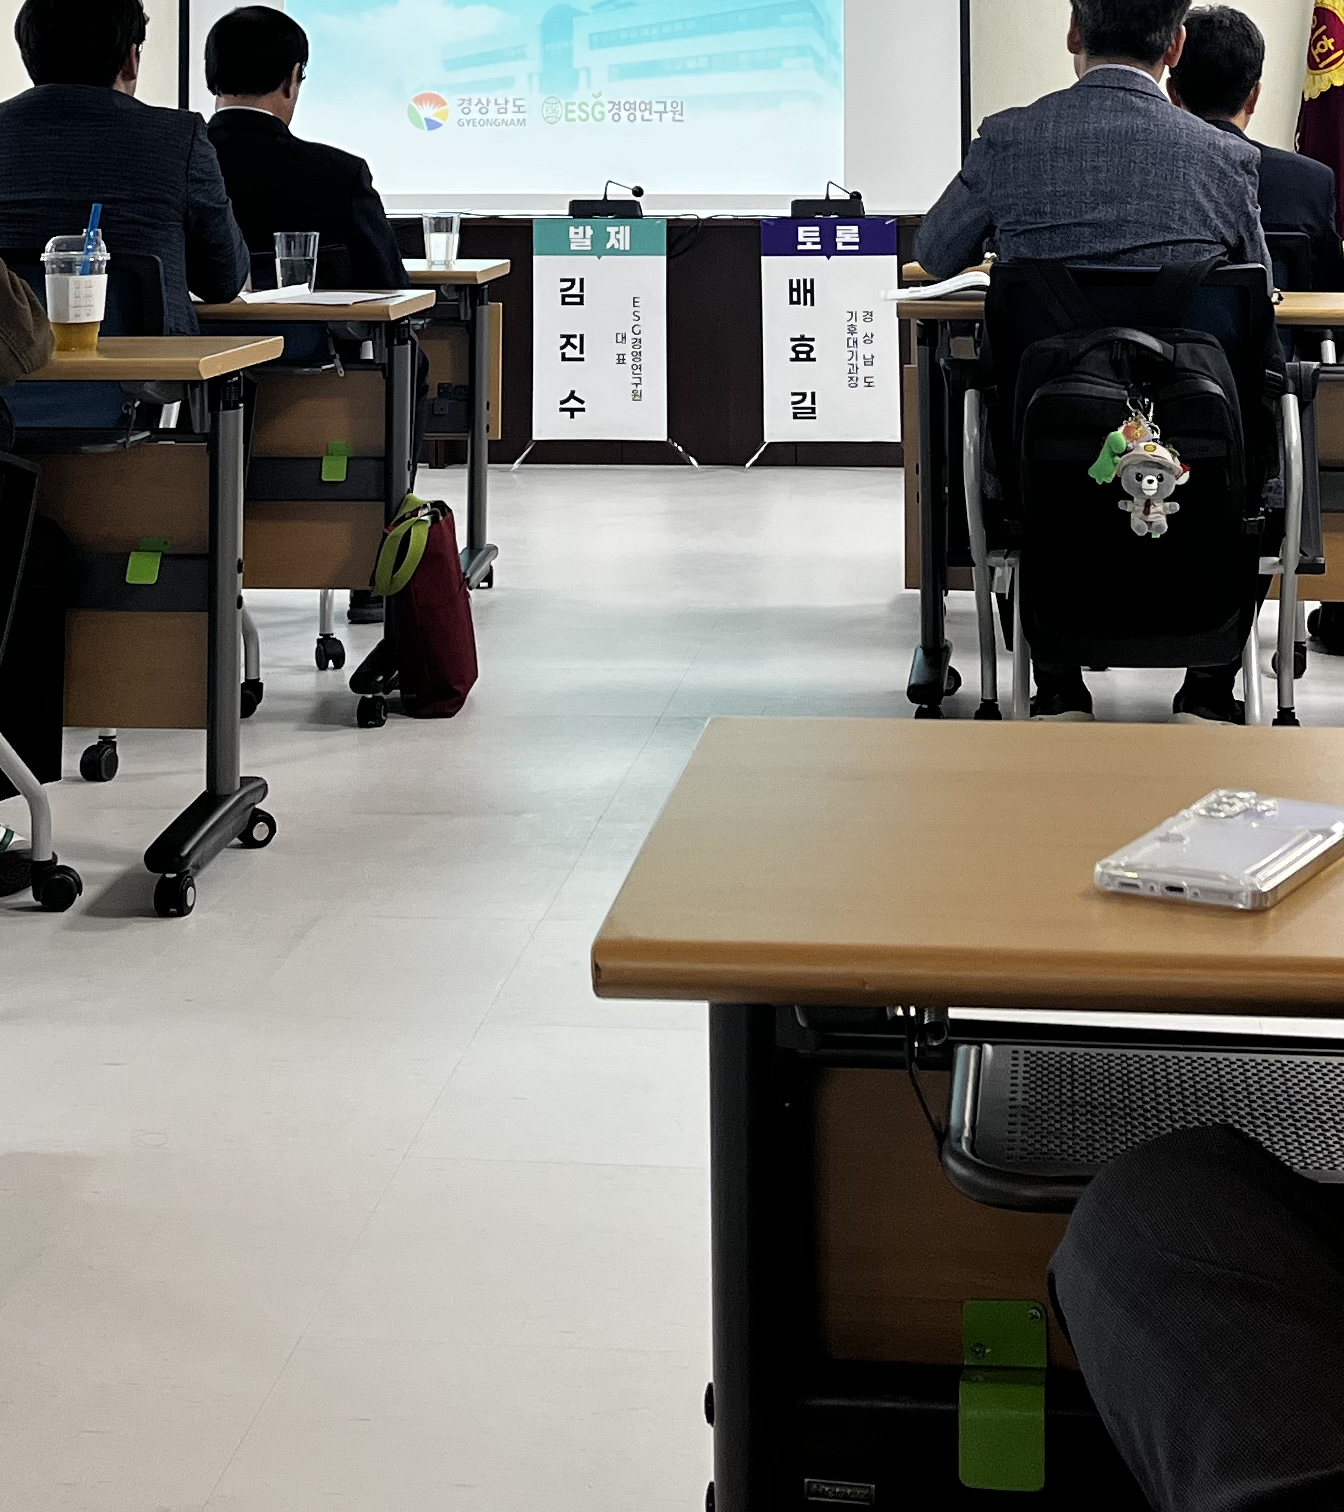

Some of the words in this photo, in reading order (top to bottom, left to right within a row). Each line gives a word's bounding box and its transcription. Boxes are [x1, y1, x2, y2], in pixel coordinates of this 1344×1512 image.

[457, 97, 527, 116] 경상남도
[565, 99, 685, 123] ESG경영연구원
[457, 117, 527, 128] GYEONGNAM
[631, 296, 643, 402] ESG경영연구원
[845, 310, 860, 389] 기후대기과장
